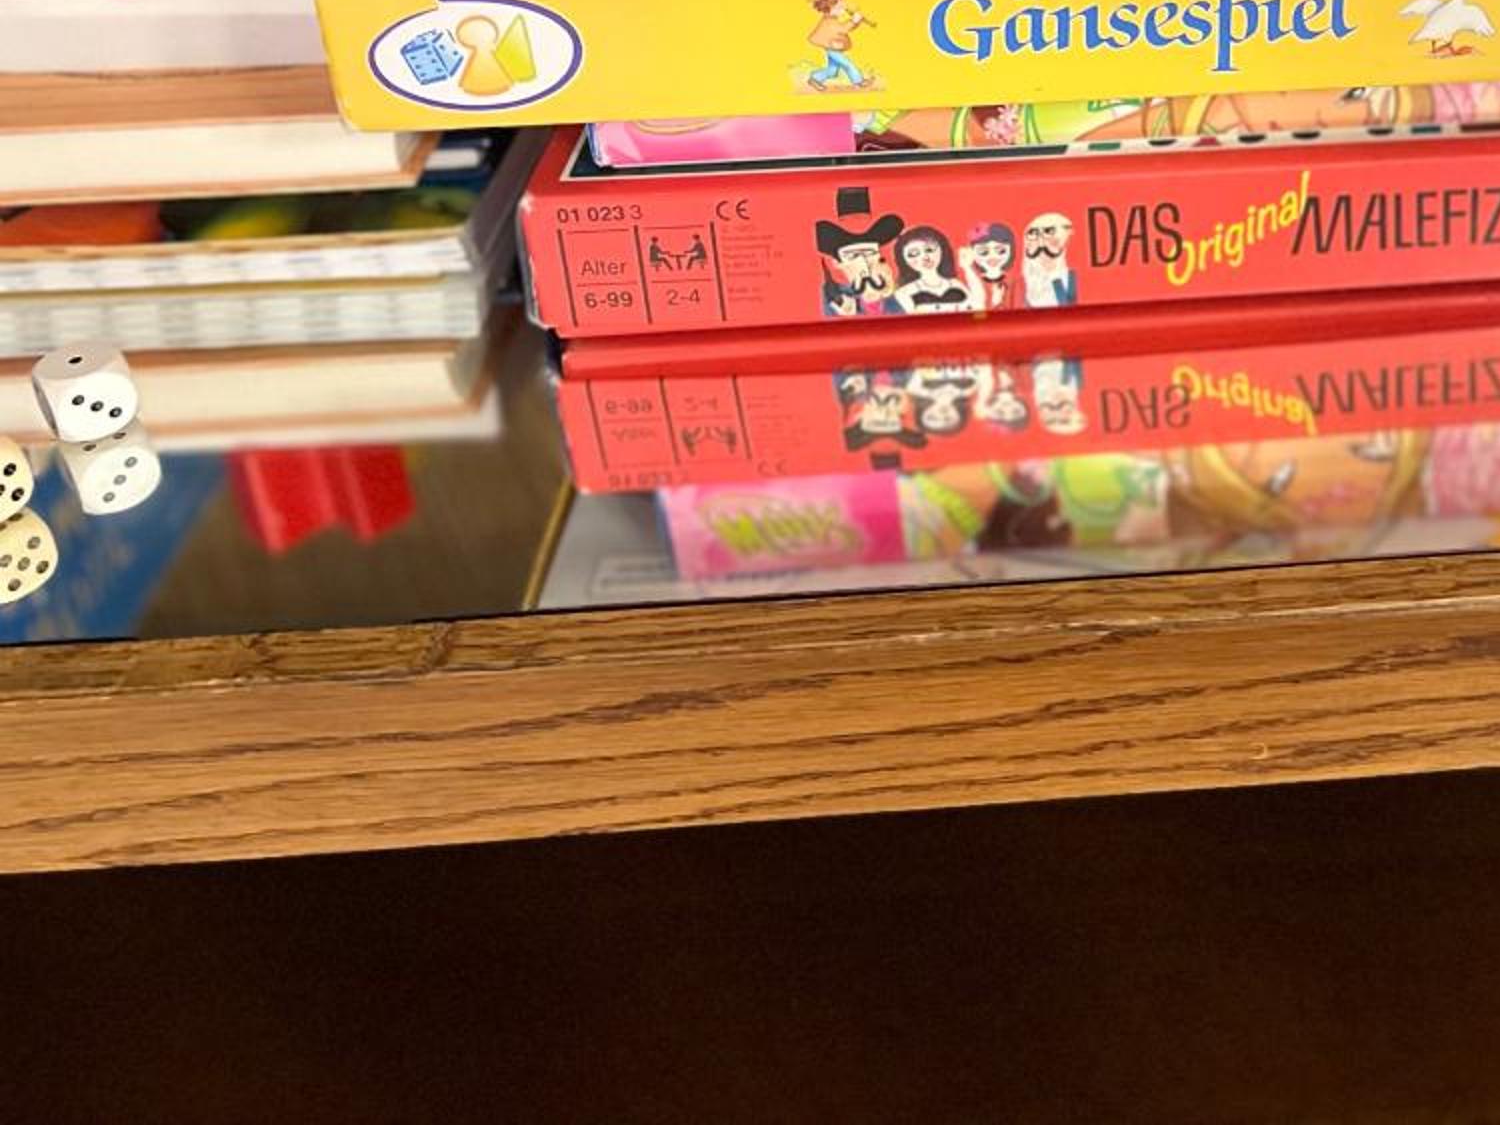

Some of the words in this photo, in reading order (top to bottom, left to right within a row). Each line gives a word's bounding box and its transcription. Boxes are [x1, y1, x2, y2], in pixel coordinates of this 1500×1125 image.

[1087, 201, 1184, 267] DAS
[1166, 169, 1311, 286] Original
[580, 258, 628, 276] Alter
[583, 291, 634, 309] 6-99
[665, 288, 701, 306] 2-4
